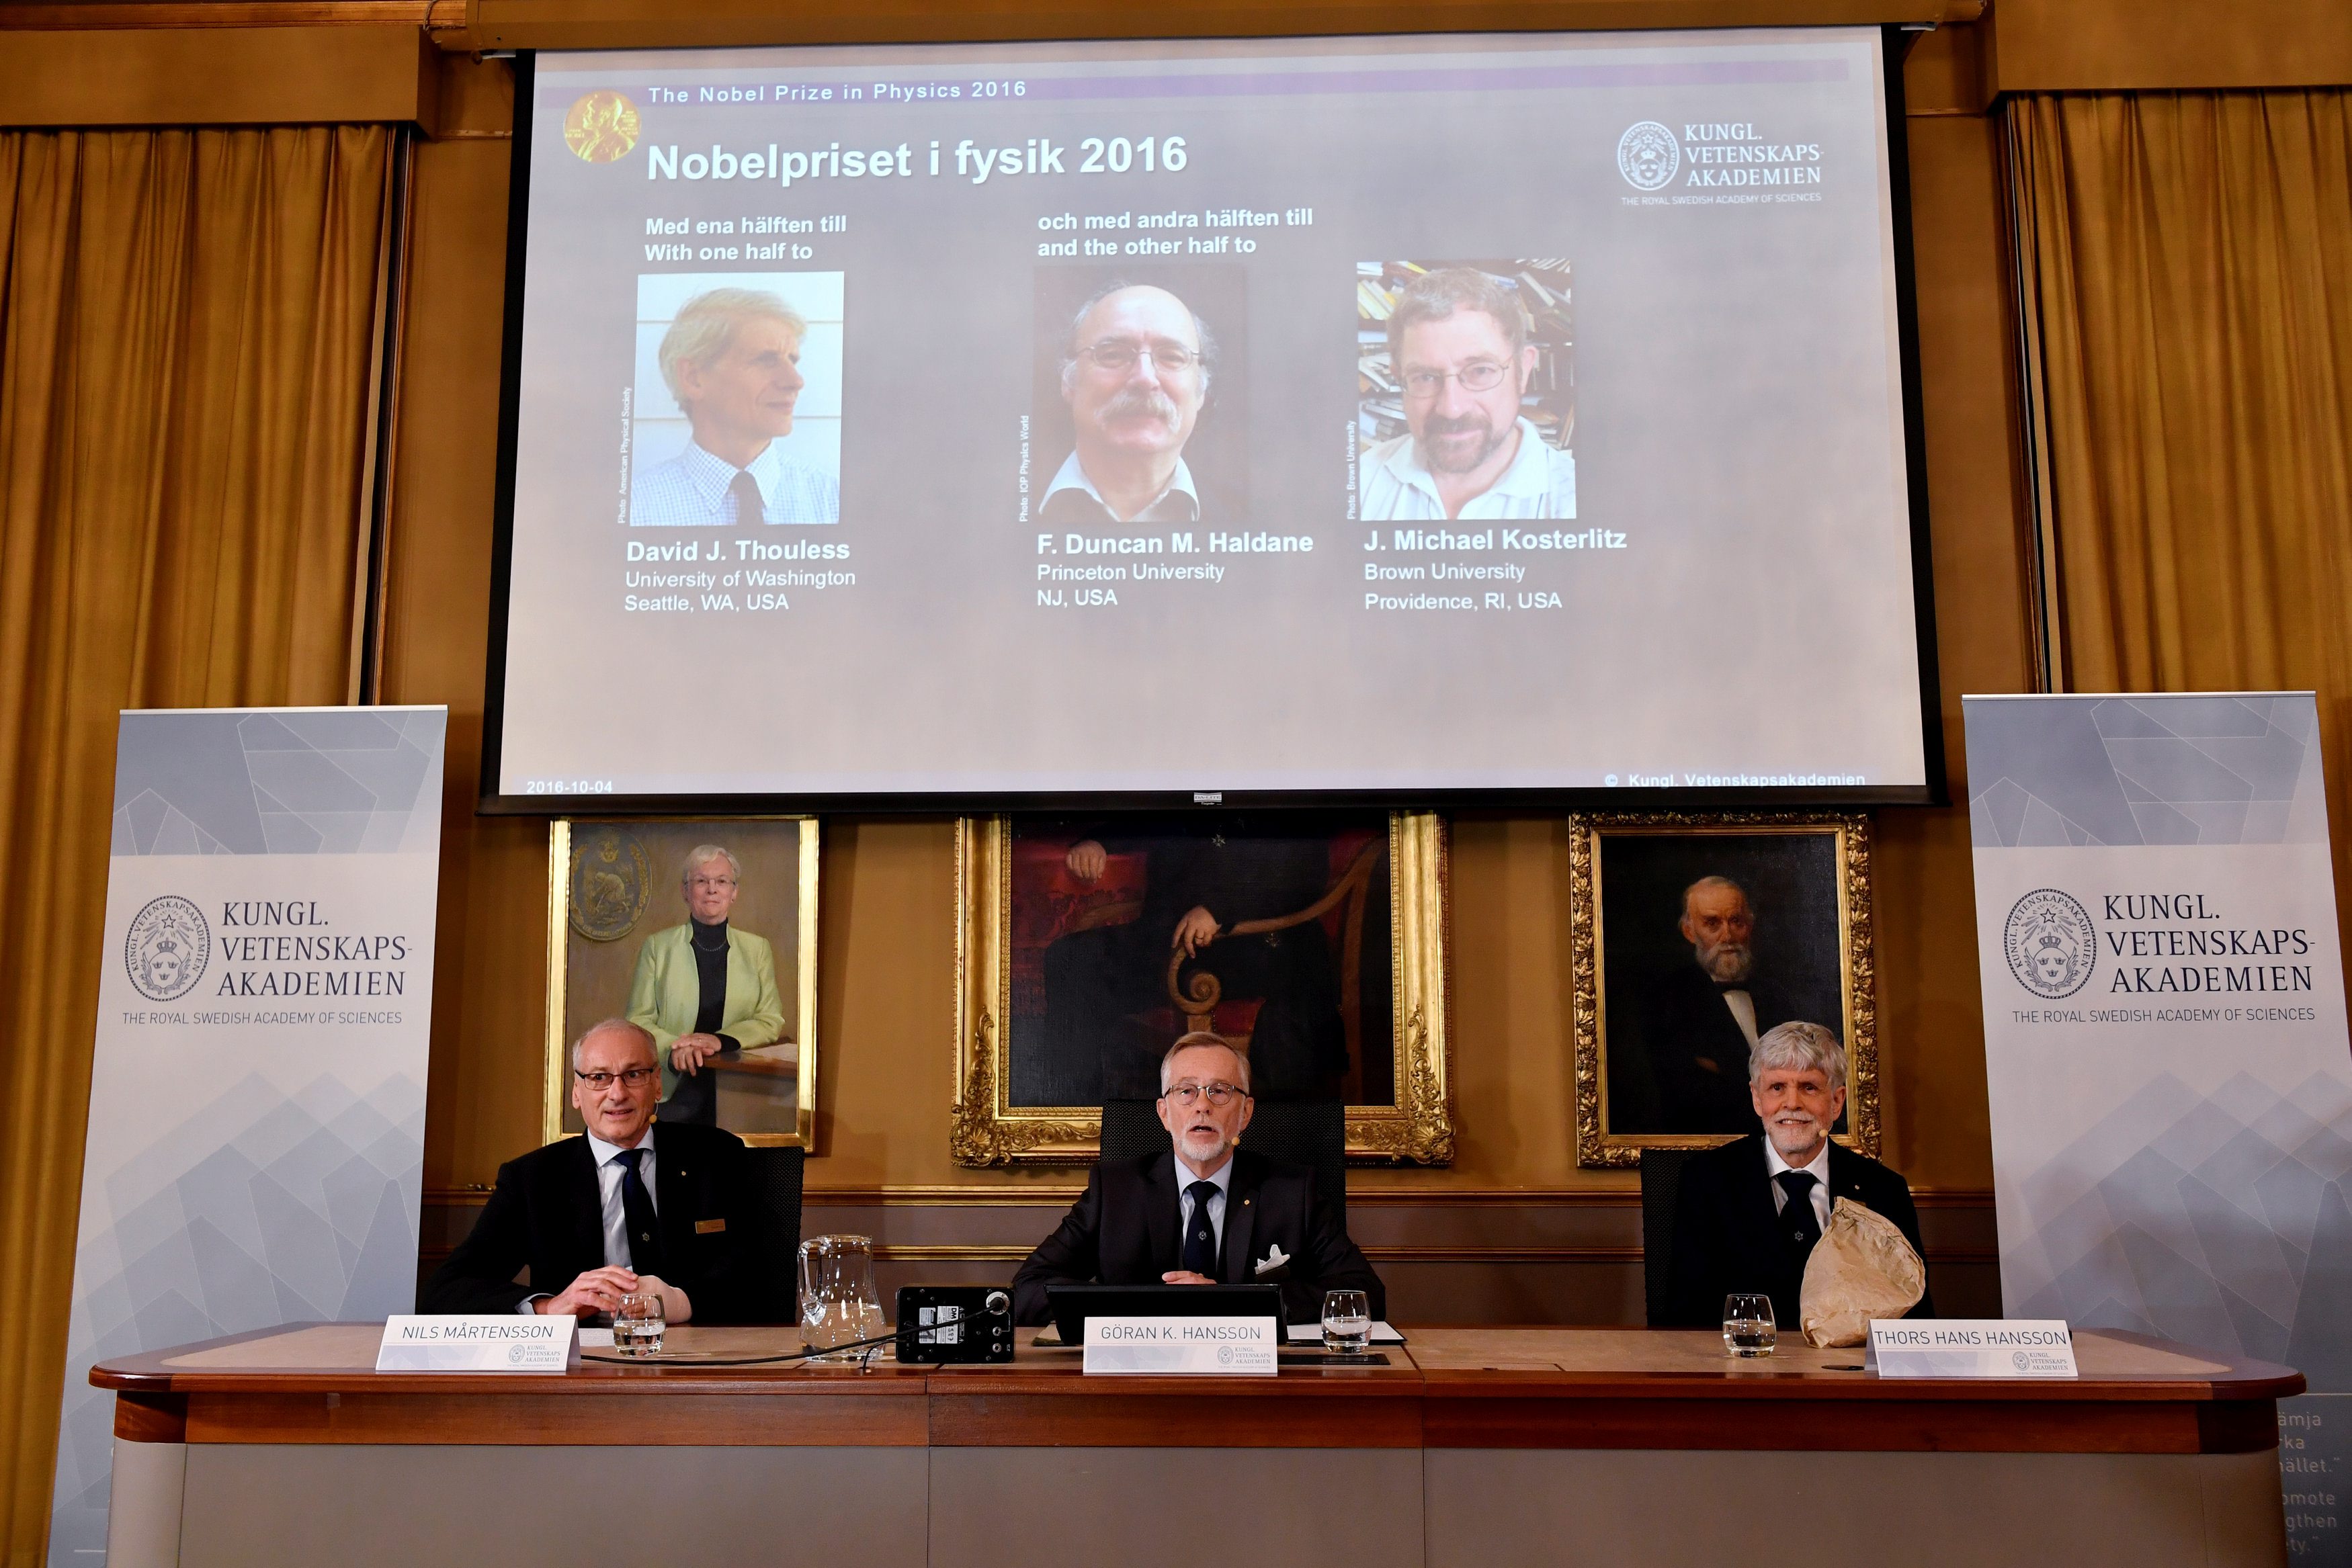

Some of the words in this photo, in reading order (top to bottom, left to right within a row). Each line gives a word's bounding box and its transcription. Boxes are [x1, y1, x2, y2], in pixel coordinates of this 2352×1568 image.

[649, 87, 688, 103] The
[700, 85, 763, 101] Nobel
[775, 84, 832, 100] Prize
[844, 83, 862, 99] in
[874, 81, 960, 102] Physics
[972, 81, 1026, 97] 2016
[1685, 123, 1762, 140] KUNGL.
[648, 143, 911, 187] Nobelpriset
[930, 140, 939, 175] i
[956, 138, 1064, 184] fysik
[1080, 136, 1187, 173] 2016
[1685, 144, 1824, 163] VETENSKAPS-
[1687, 167, 1821, 186] AKADEMIEN
[1622, 198, 1639, 206] THE
[1642, 197, 1670, 205] ROYAL
[1673, 195, 1713, 205] SWEDISH
[1716, 195, 1759, 204] ACADEMY
[1761, 194, 1773, 203] OF
[1775, 193, 1822, 202] SCIENCES
[646, 217, 691, 234] Med
[697, 222, 734, 234] ena
[741, 216, 813, 234] hälften
[821, 216, 847, 232] till
[1038, 214, 1077, 230] och
[1085, 212, 1130, 229] med
[1138, 211, 1198, 228] andra
[1206, 210, 1279, 227] hälften
[1286, 208, 1312, 226] till
[645, 244, 693, 261] With
[700, 248, 738, 261] one
[745, 243, 785, 259] half
[792, 244, 812, 259] to
[1038, 239, 1077, 257] and
[1085, 238, 1118, 255] the
[1125, 237, 1181, 255] other
[1188, 236, 1228, 254] half
[1234, 236, 1256, 253] to
[620, 419, 630, 453] Physical
[1020, 415, 1030, 440] World
[1020, 442, 1030, 474] Physics
[619, 455, 628, 494] American
[1019, 476, 1028, 492] IOP
[1347, 464, 1355, 490] Brown
[1038, 534, 1057, 554] F.
[1066, 533, 1163, 554] Duncan
[1173, 533, 1200, 554] M.
[1210, 531, 1314, 552] Haldane
[1364, 530, 1386, 551] J.
[1395, 529, 1493, 550] Michael
[1503, 529, 1627, 550] Kosterlitz
[627, 541, 698, 562] David
[706, 541, 726, 562] J.
[736, 539, 850, 560] Thouless
[626, 570, 715, 591] University
[723, 570, 740, 586] of
[746, 570, 855, 590] Washington
[1038, 564, 1126, 580] Princeton
[1133, 563, 1224, 583] University
[1365, 564, 1425, 580] Brown
[1431, 563, 1525, 583] University
[624, 595, 694, 613] Seattle,
[701, 594, 739, 612] WA,
[747, 593, 789, 611] USA
[1038, 590, 1068, 608] NJ,
[1075, 589, 1118, 606] USA
[1366, 593, 1478, 612] Providence,
[1485, 593, 1510, 611] RI,
[1518, 593, 1562, 609] USA
[527, 781, 612, 793] 2016-10-04
[1629, 774, 1679, 789] Kungl.
[1685, 773, 1865, 788] Vetenskapsakademien
[222, 902, 329, 926] KUNGL.
[2103, 894, 2220, 920] KUNGL.
[134, 901, 205, 971] VETENSKAPSAKADEMIEN
[2011, 894, 2091, 968] VETENSKAPSAKADEMIEN
[130, 933, 139, 971] KUNGL.
[221, 936, 413, 961] VETENSKAPS-
[2010, 928, 2023, 968] KUNGL.
[2105, 929, 2316, 956] VETENSKAPS-
[216, 971, 406, 996] AKADEMIEN
[2109, 965, 2312, 992] AKADEMIEN
[123, 1012, 146, 1025] THE
[149, 1012, 189, 1025] ROYAL
[193, 1012, 251, 1024] SWEDISH
[254, 1012, 315, 1024] ACADEMY
[319, 1012, 335, 1024] OF
[339, 1012, 402, 1024] SCIENCES
[2013, 1010, 2039, 1022] THE
[2044, 1010, 2086, 1022] ROYAL
[2090, 1009, 2152, 1022] SWEDISH
[2156, 1008, 2220, 1021] ACADEMY
[2224, 1008, 2242, 1020] OF
[2246, 1008, 2315, 1020] SCIENCES
[951, 1308, 956, 1319] DM
[403, 1326, 439, 1339] NILS
[444, 1322, 554, 1338] MÅRTENSSON
[1101, 1323, 1157, 1340] GÖRAN
[1163, 1327, 1177, 1340] K.
[1183, 1327, 1261, 1340] HANSSON
[1874, 1331, 1930, 1344] THORS
[1935, 1332, 1980, 1344] HANS
[1986, 1332, 2066, 1344] HANSSON
[2278, 1411, 2321, 1430] ämja
[2282, 1491, 2335, 1505] omote
[2286, 1514, 2337, 1532] gthen
